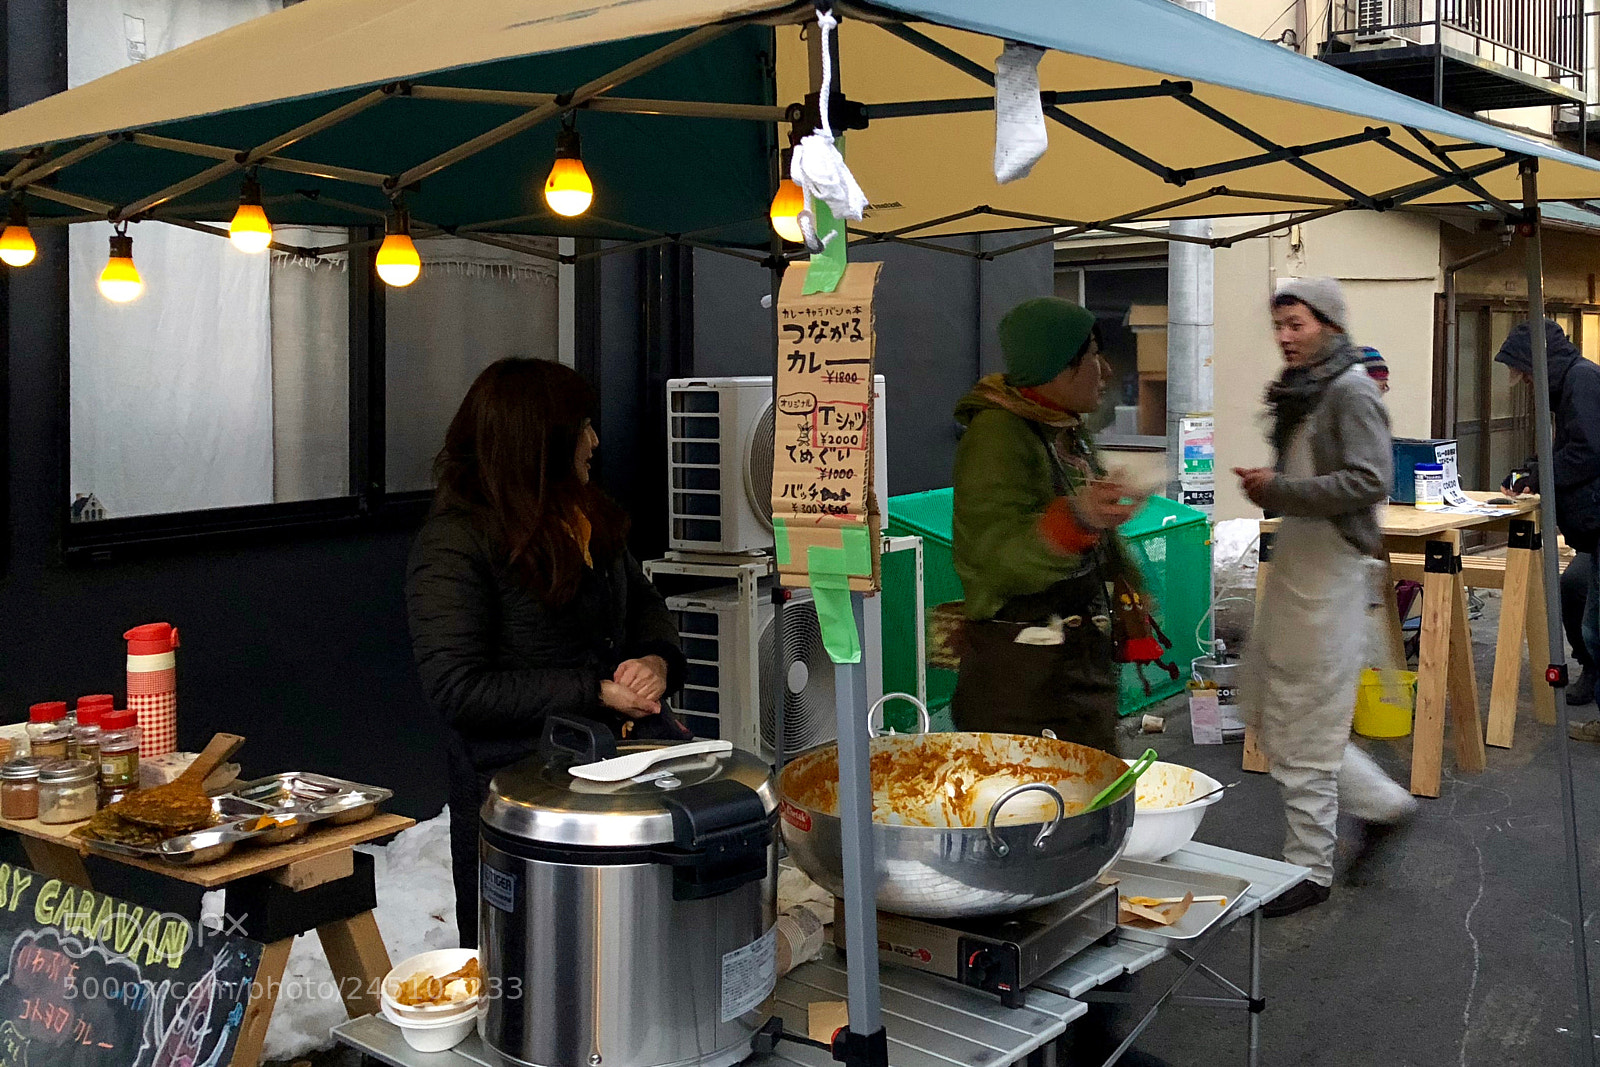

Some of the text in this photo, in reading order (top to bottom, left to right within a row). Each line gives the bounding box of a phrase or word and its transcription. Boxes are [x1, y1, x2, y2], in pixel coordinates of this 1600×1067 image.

[783, 318, 864, 344] つながる
[787, 350, 870, 374] カレー
[826, 370, 858, 384] ¥1800
[780, 399, 813, 409] オリジナル
[818, 406, 867, 431] Tシャツ
[820, 432, 859, 446] ¥2000
[819, 468, 854, 481] ¥1000
[34, 879, 189, 969] CARAVAN
